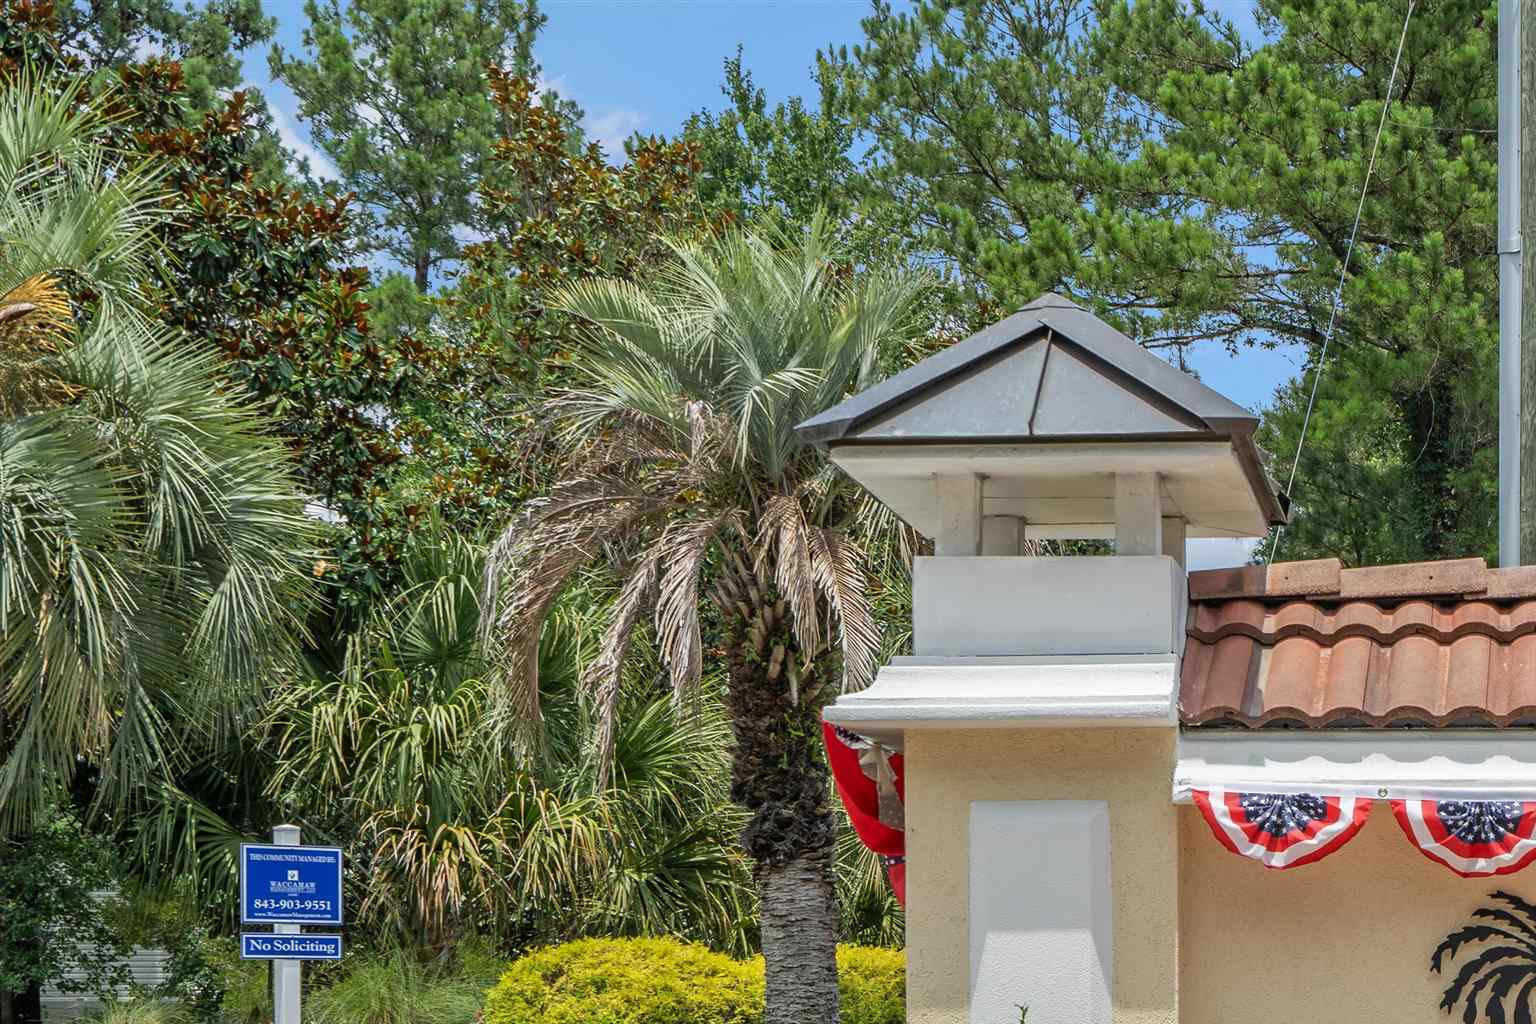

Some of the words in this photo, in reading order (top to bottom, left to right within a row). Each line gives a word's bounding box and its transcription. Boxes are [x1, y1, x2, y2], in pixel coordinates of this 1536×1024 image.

[270, 881, 317, 889] WACCAMAW
[253, 899, 332, 911] 843-903-9551
[249, 939, 272, 951] No
[273, 940, 336, 954] Soliciting
